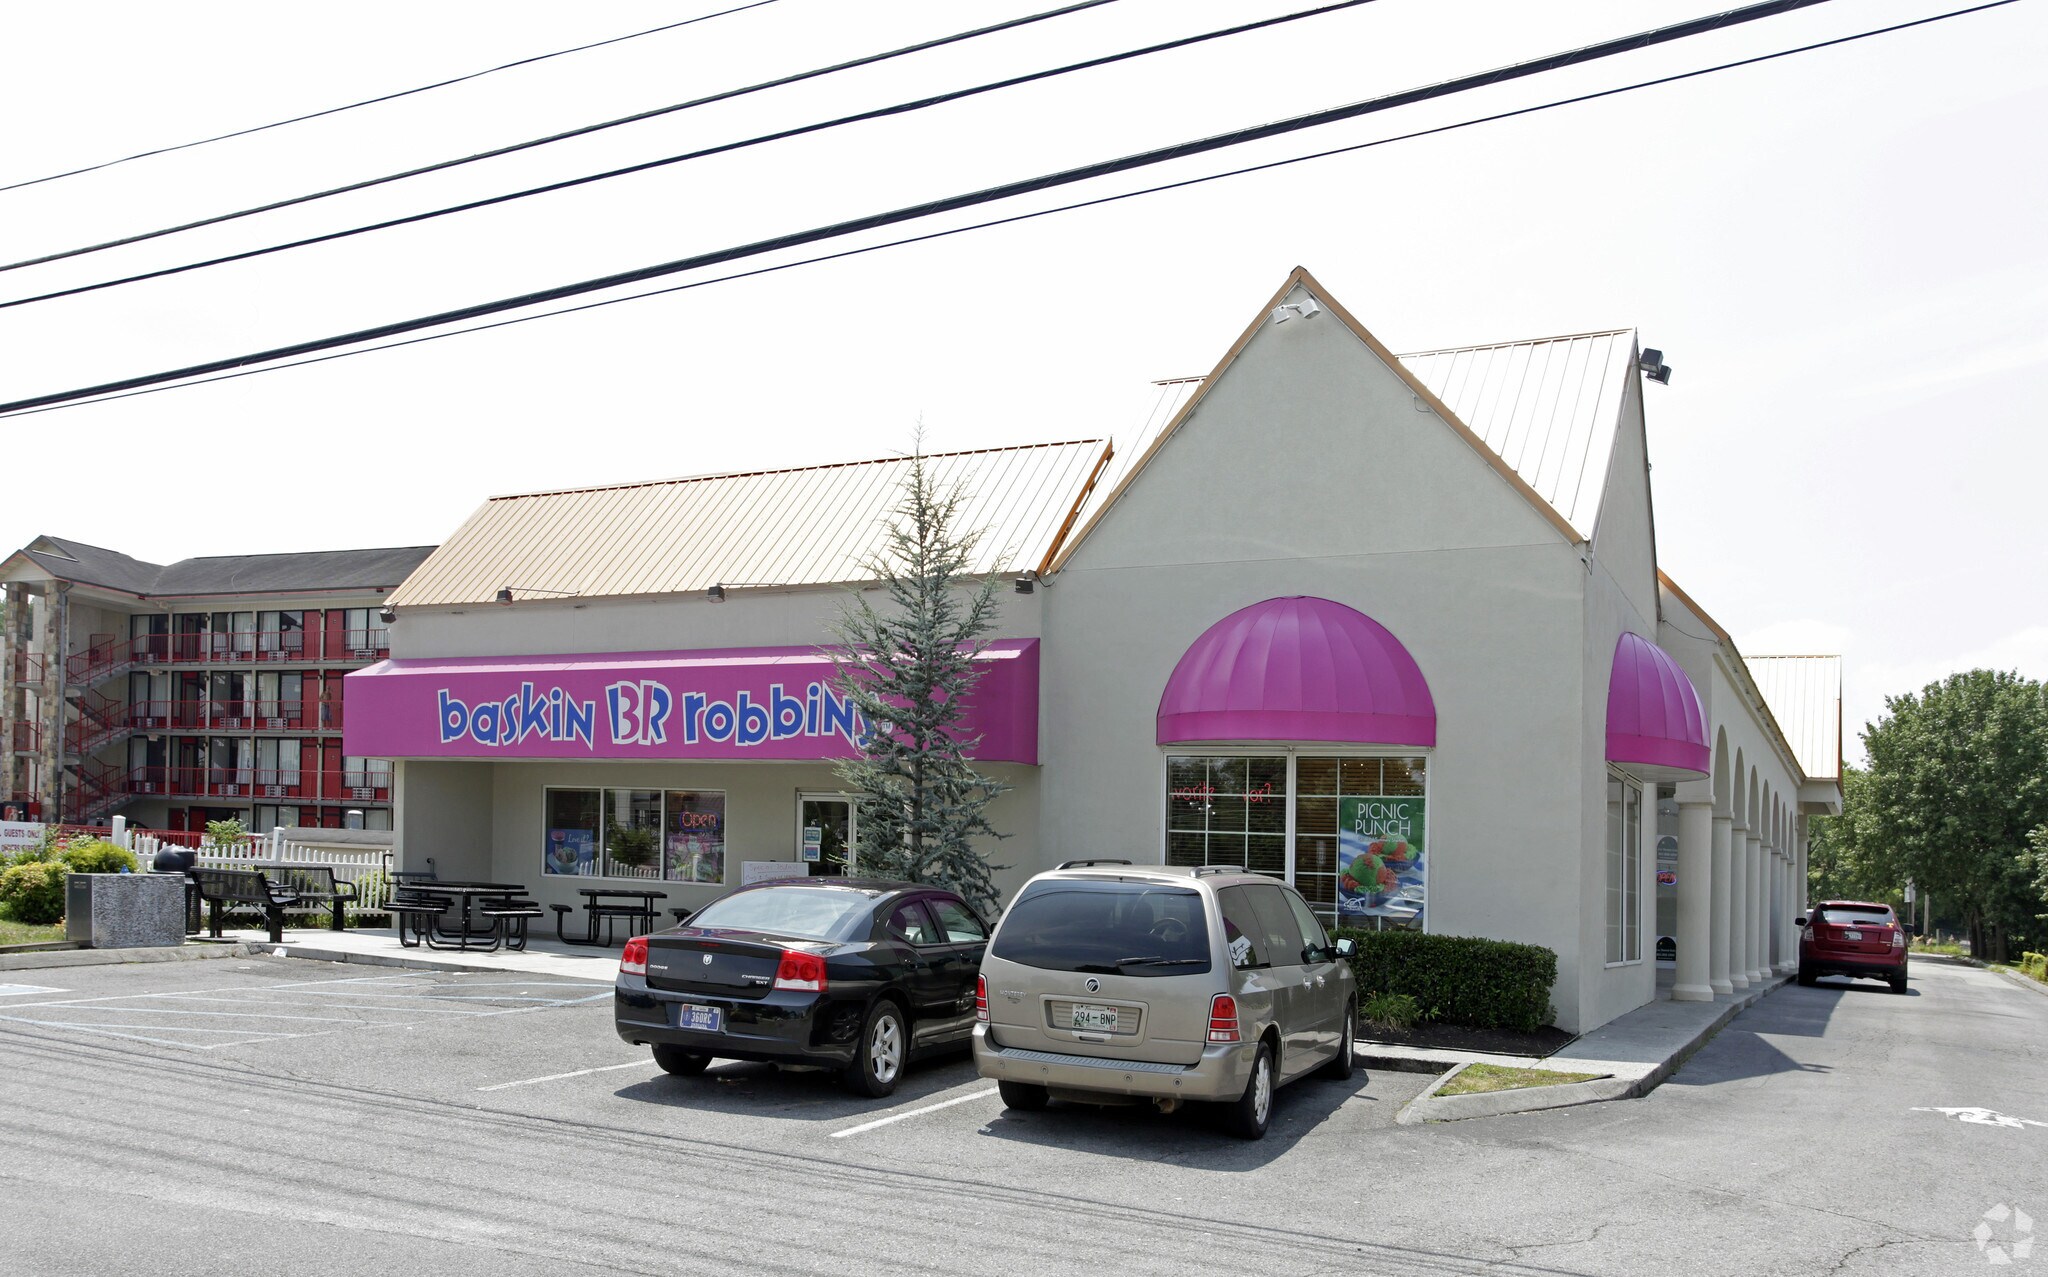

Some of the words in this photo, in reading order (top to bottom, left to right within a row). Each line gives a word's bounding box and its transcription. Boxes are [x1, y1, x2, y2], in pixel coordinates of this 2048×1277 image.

[605, 679, 673, 746] BR
[682, 811, 717, 829] Open
[1357, 802, 1409, 820] PICNIC
[4, 829, 25, 838] GUESTS
[1355, 819, 1411, 836] PUNCH
